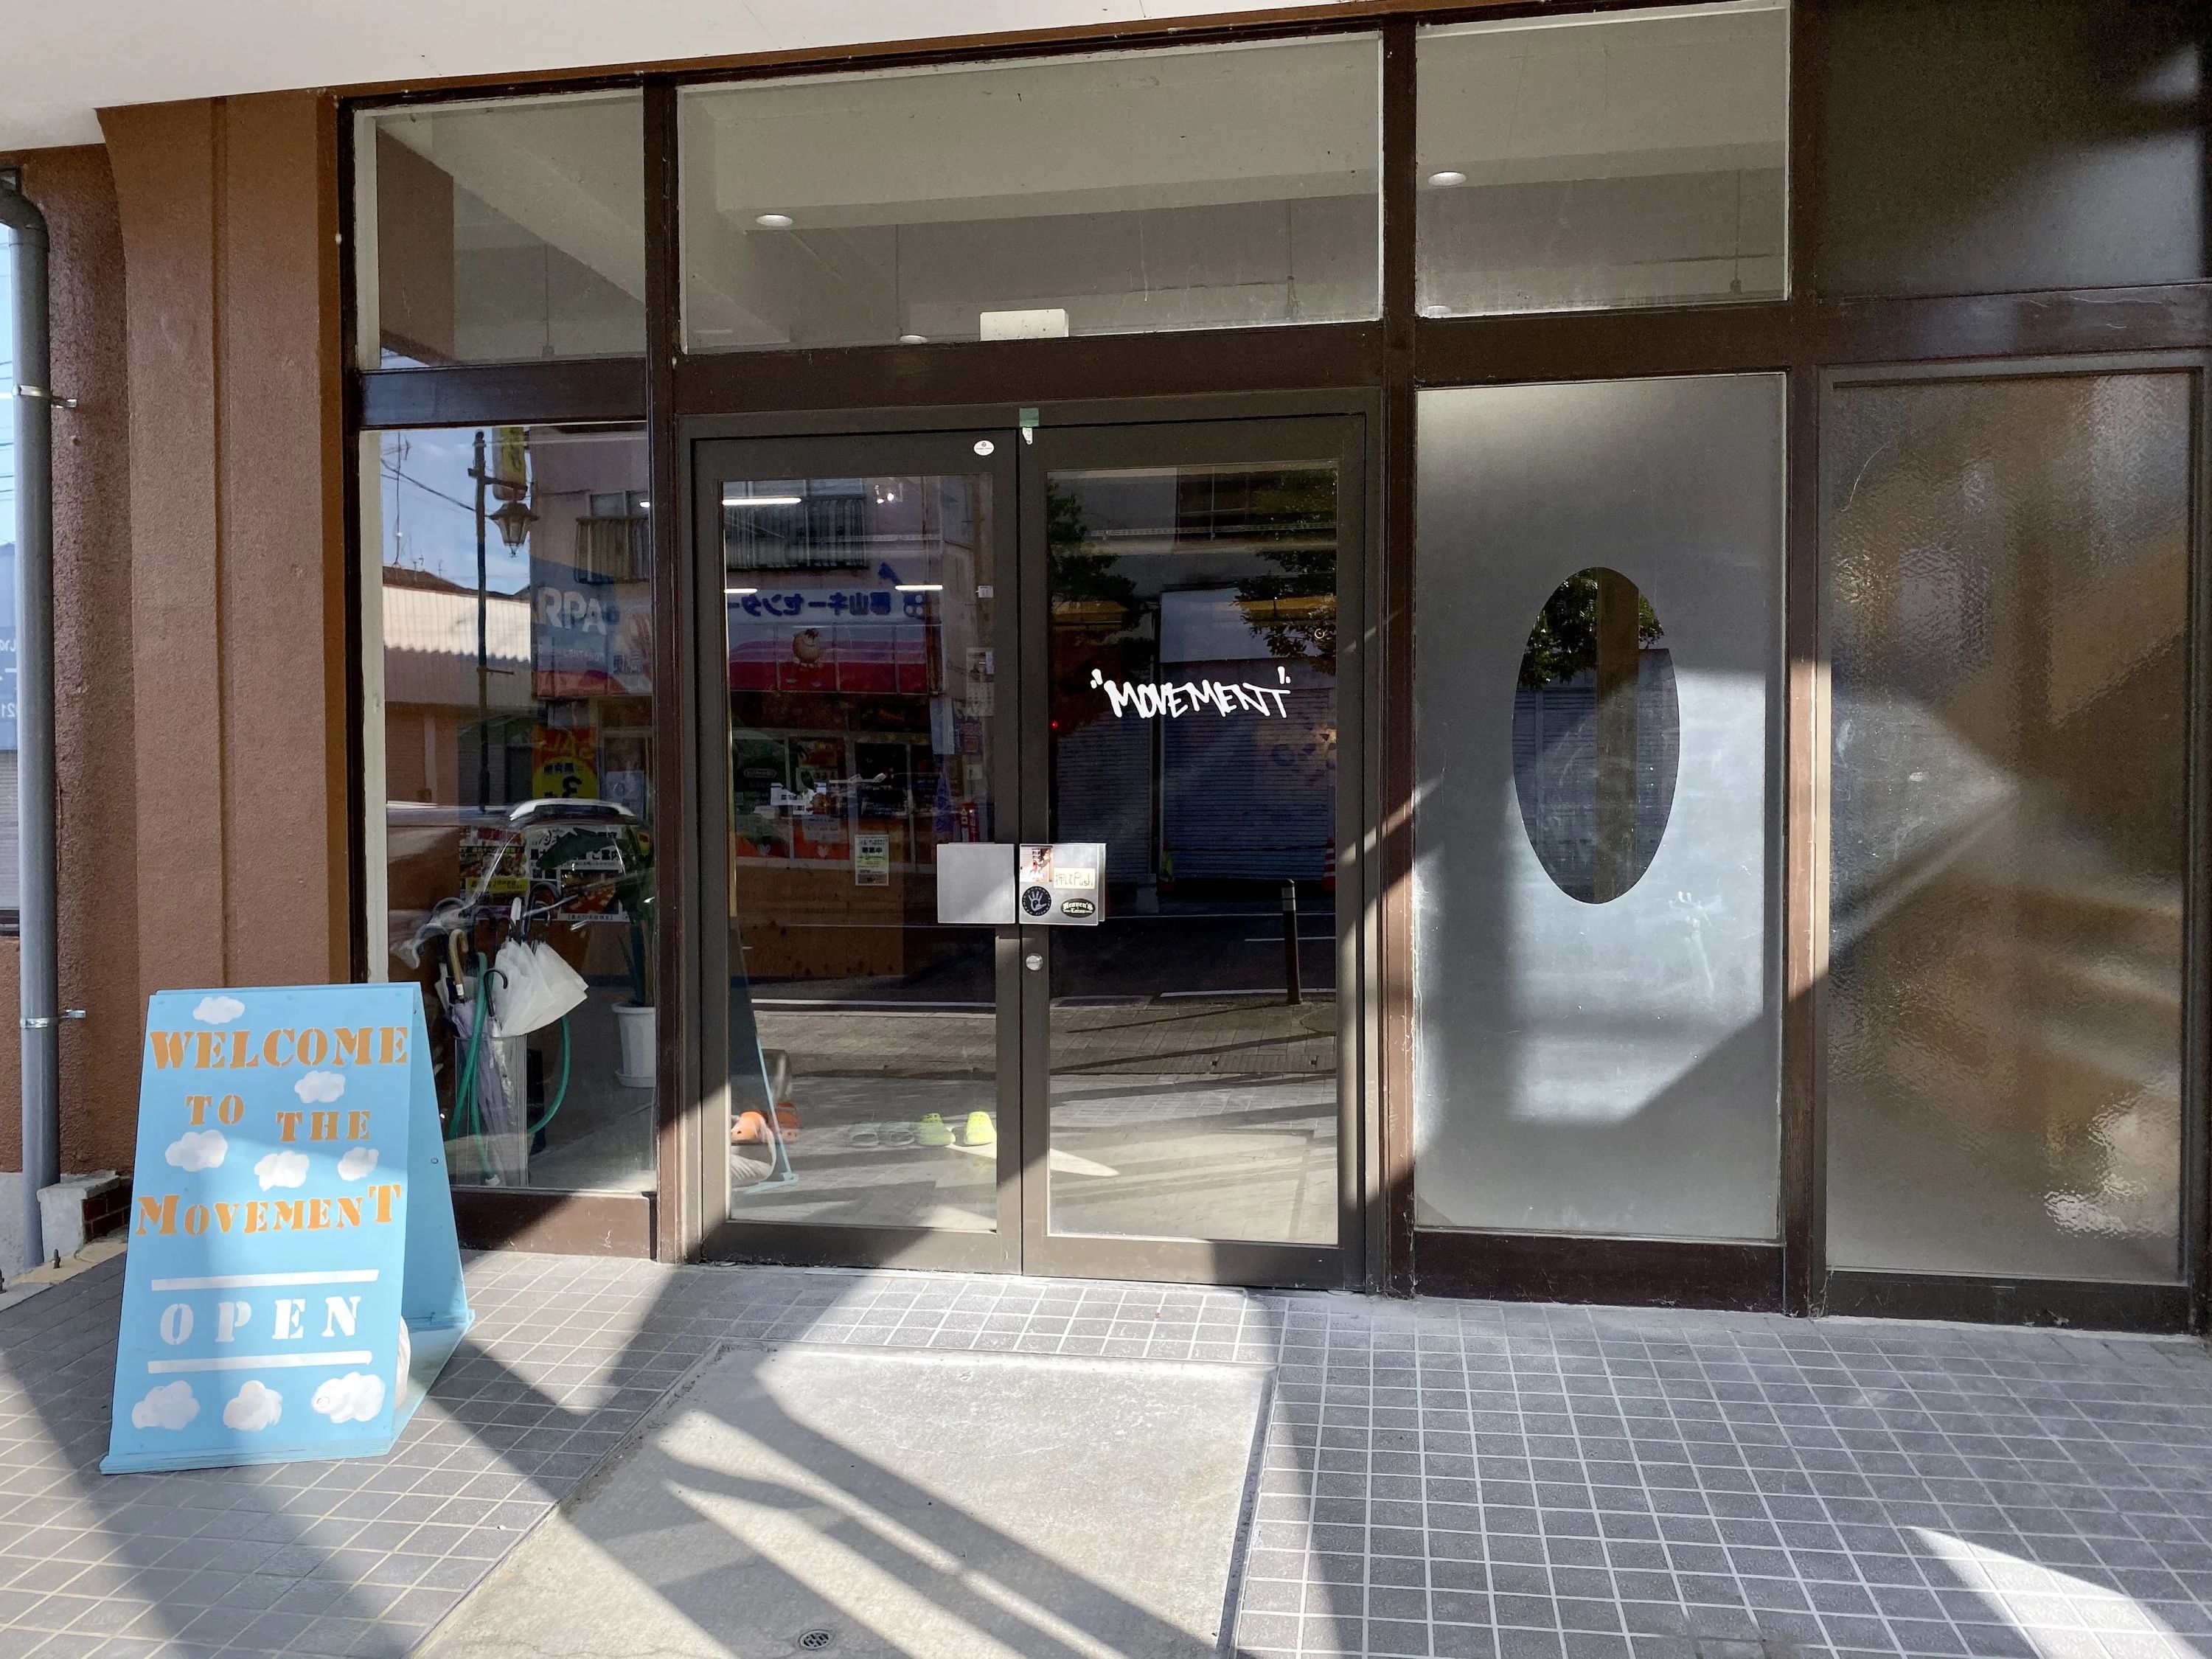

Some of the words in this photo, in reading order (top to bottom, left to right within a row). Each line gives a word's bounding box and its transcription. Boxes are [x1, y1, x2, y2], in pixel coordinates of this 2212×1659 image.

[149, 1026, 408, 1069] WELCOME
[185, 1093, 245, 1125] TO
[276, 1110, 372, 1142] THE
[159, 1295, 361, 1345] OPEN
